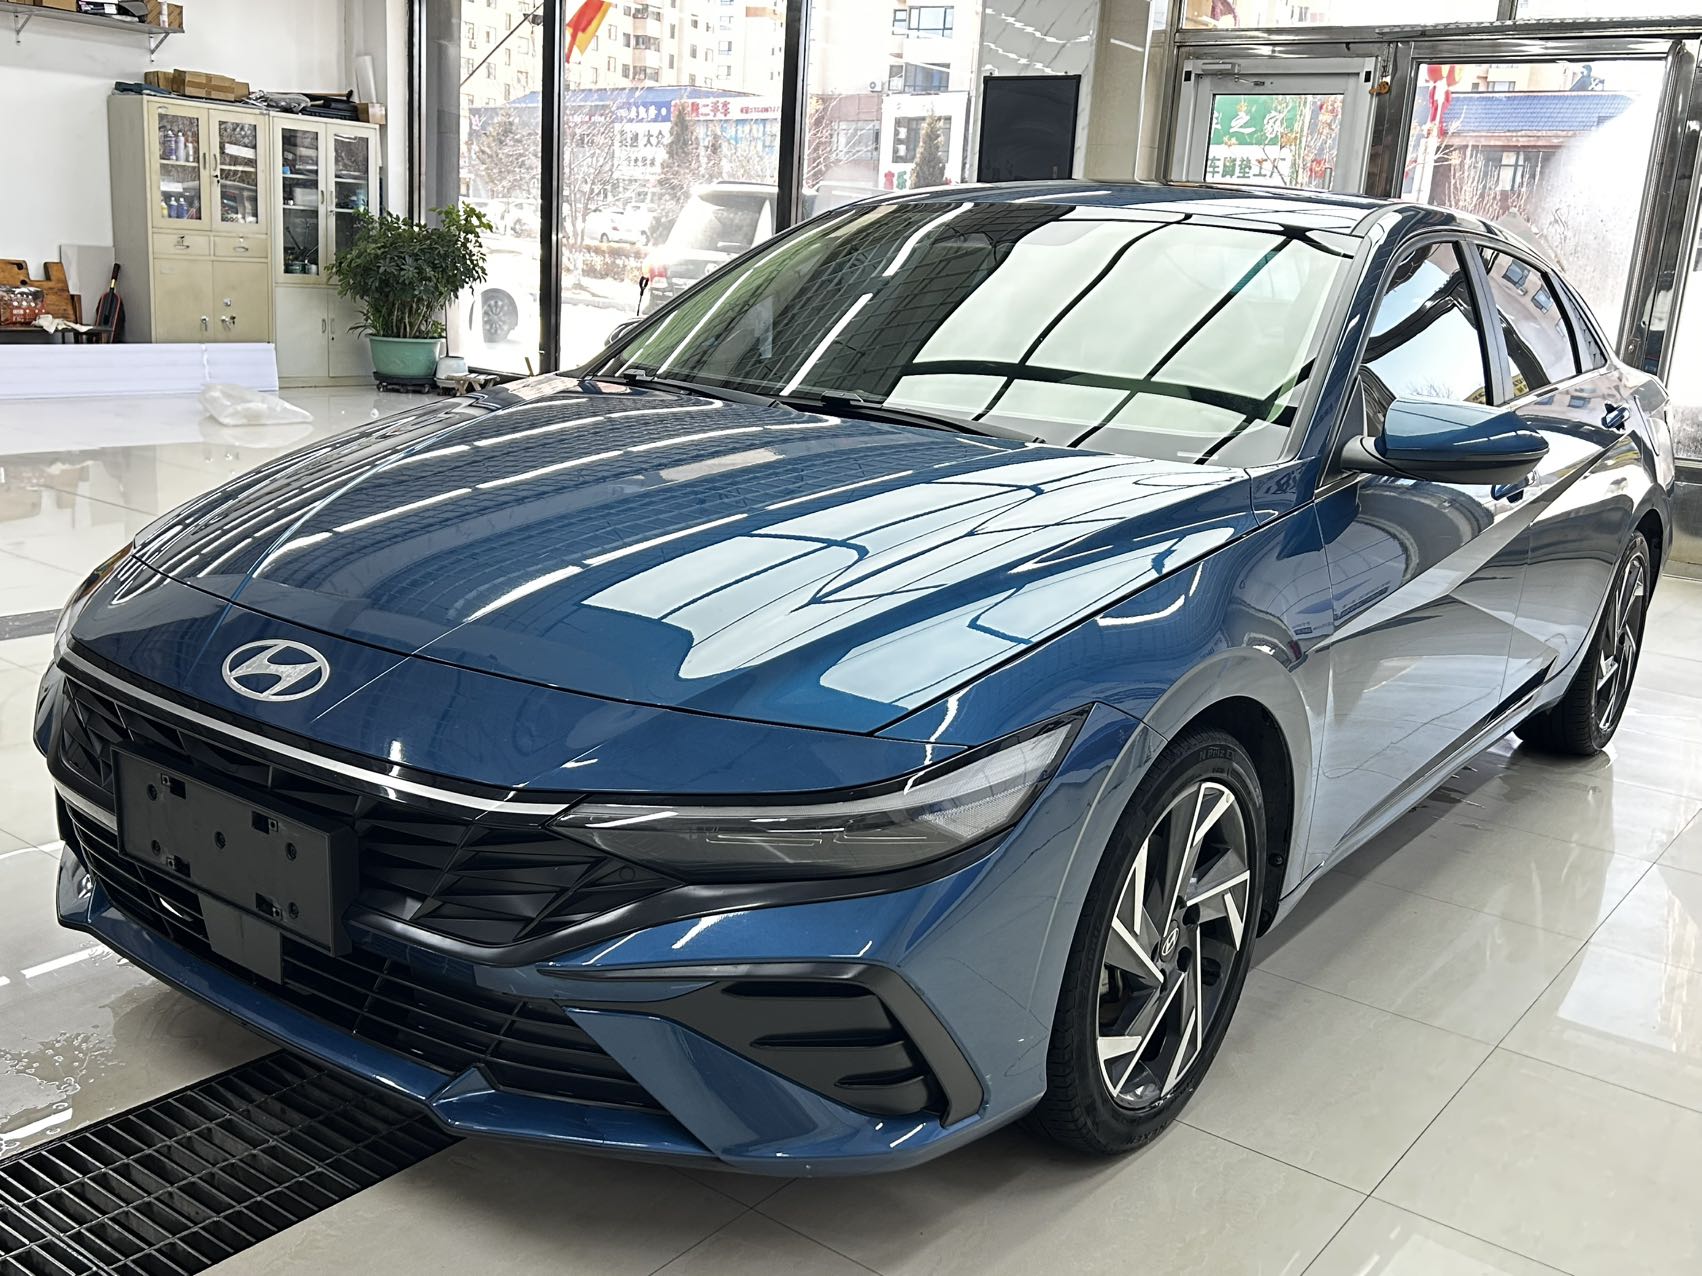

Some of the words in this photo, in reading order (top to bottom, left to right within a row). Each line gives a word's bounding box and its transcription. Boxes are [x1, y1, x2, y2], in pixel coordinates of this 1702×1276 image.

[644, 129, 665, 148] 大众
[1208, 156, 1286, 178] 车脚垫工厂
